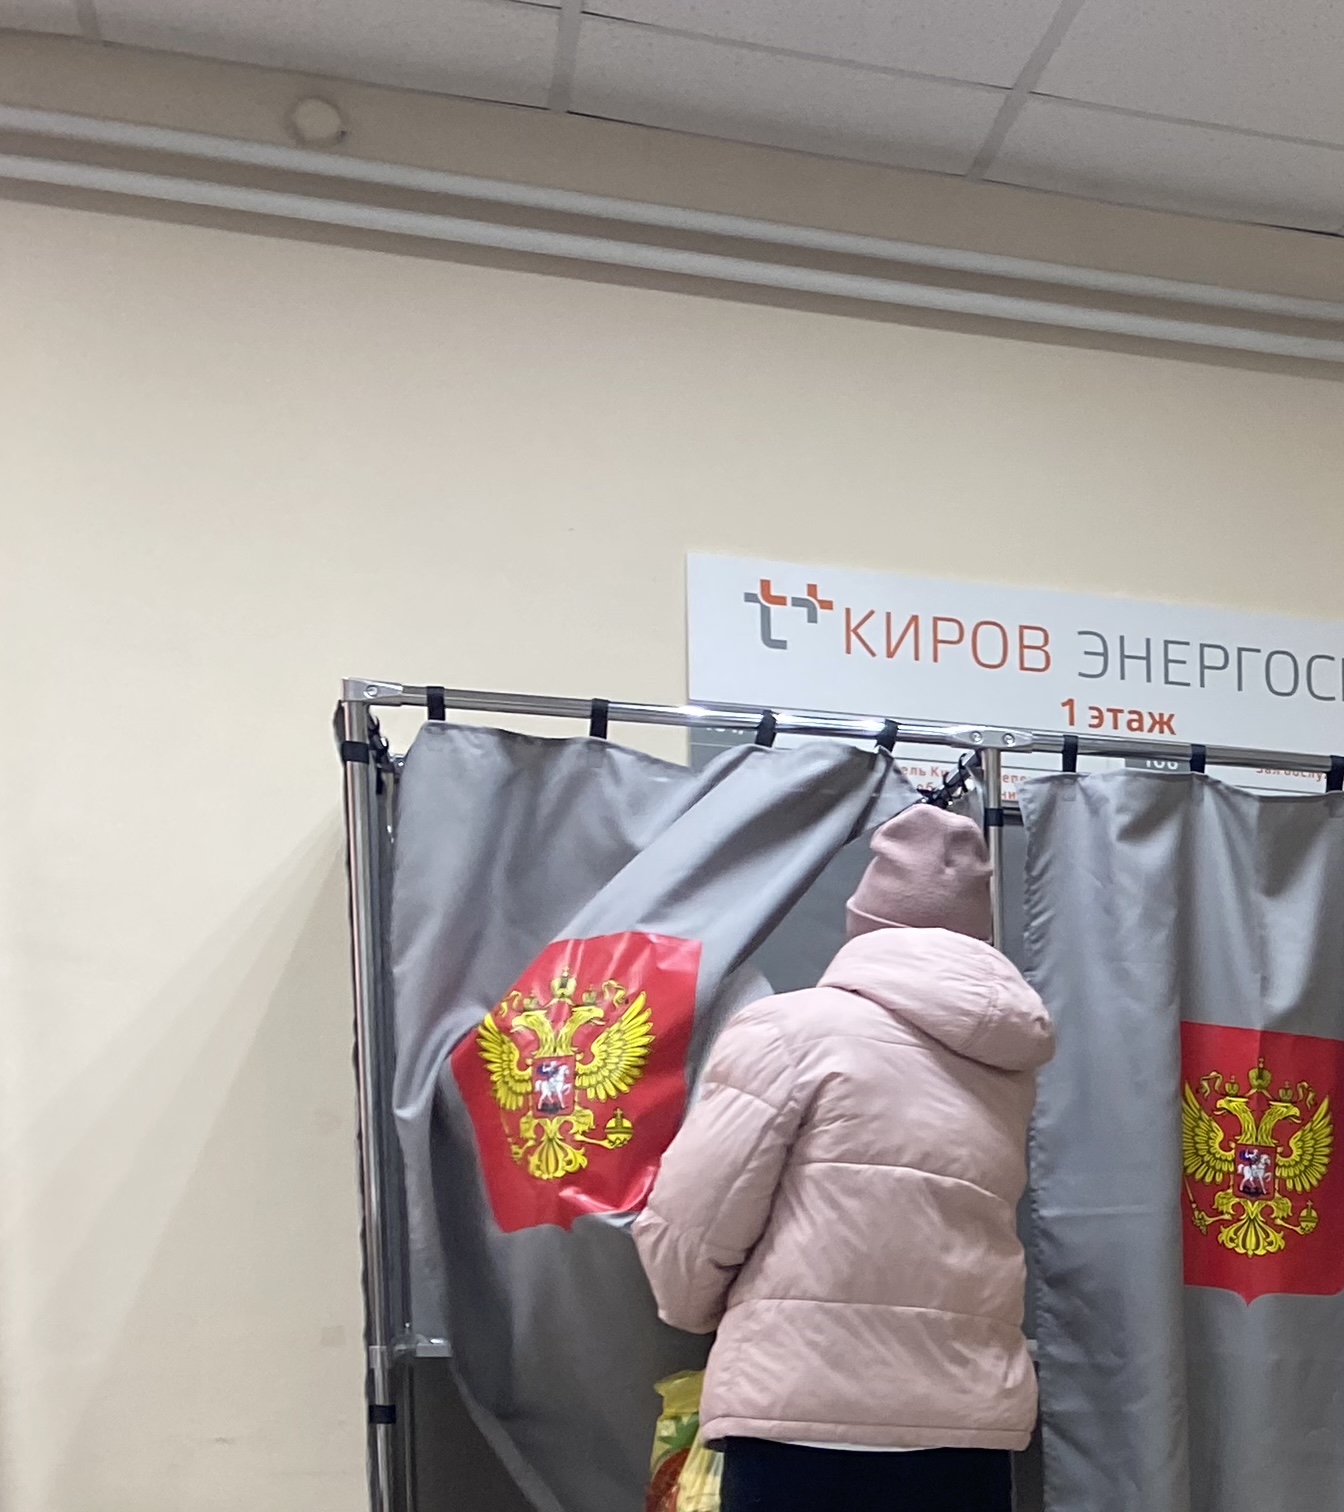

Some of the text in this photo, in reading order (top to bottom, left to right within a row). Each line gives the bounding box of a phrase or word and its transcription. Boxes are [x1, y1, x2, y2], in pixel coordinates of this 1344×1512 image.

[844, 607, 1052, 673] КИРОВ
[1061, 698, 1177, 736] 1 этаж
